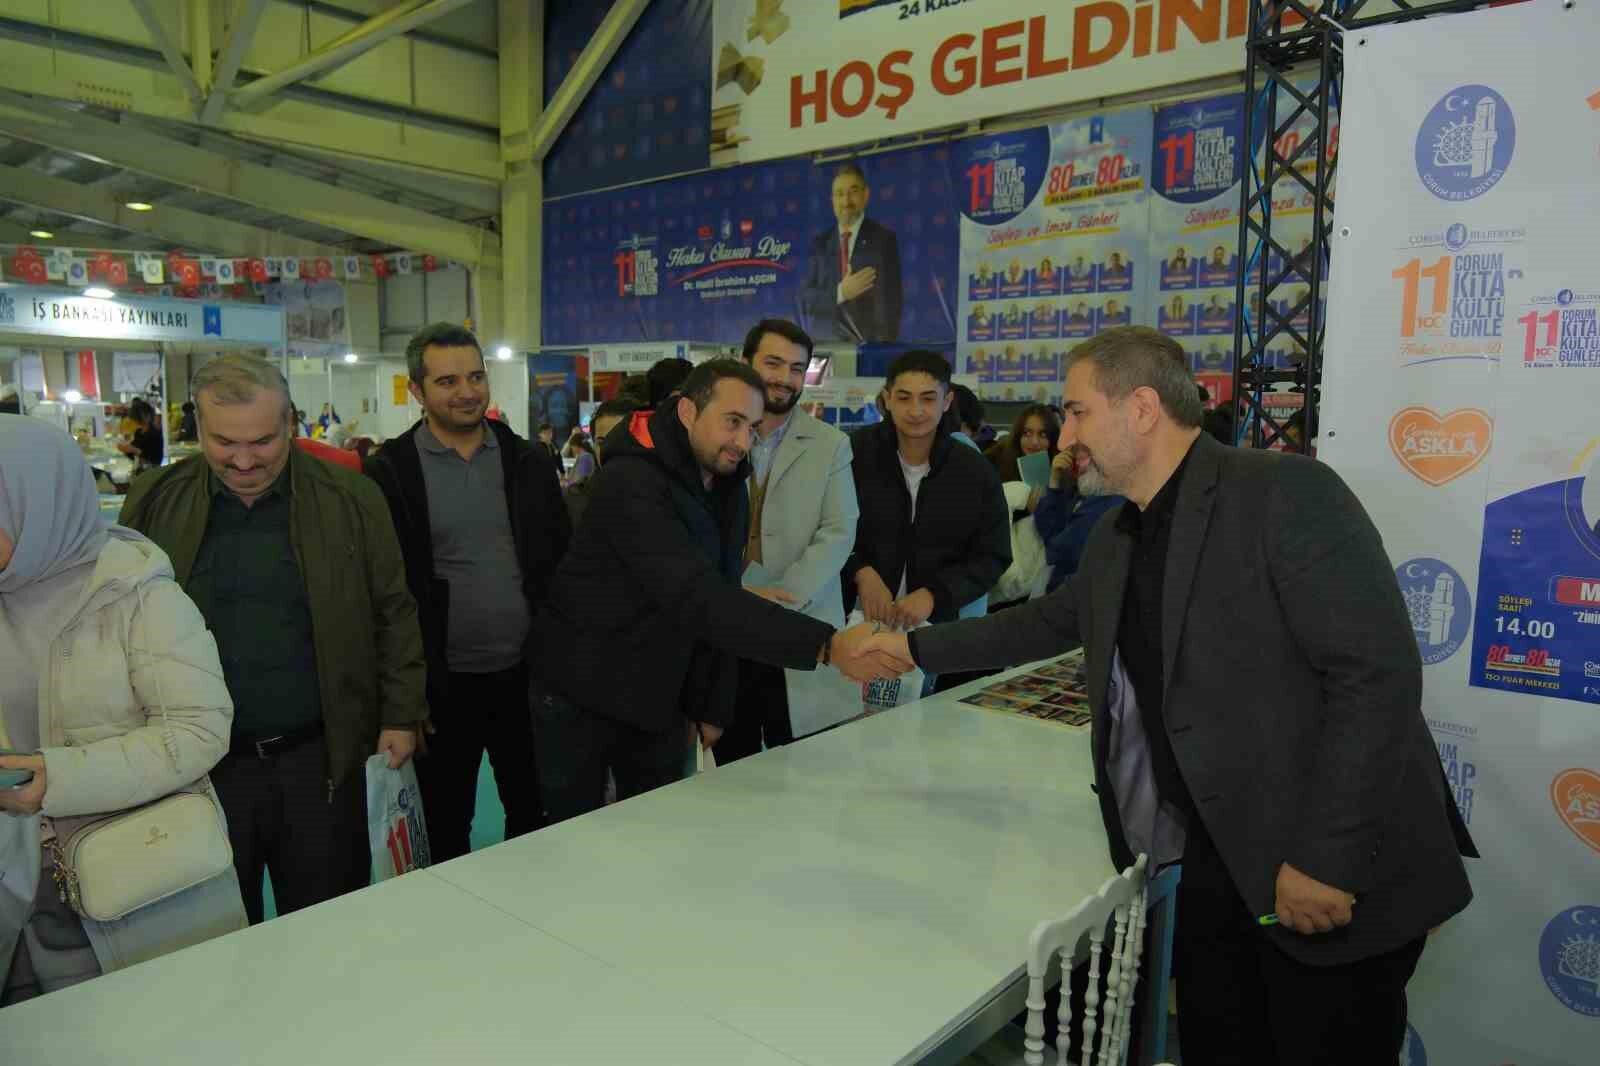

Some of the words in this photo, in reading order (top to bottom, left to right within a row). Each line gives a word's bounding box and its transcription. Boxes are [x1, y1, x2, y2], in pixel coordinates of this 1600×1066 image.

[897, 1, 920, 20] 24
[789, 50, 914, 128] HOŞ
[1047, 161, 1074, 193] 80
[1096, 153, 1125, 184] 80
[1160, 128, 1194, 190] 11
[966, 161, 993, 212] 11
[119, 307, 189, 329] YAYINLARI
[1391, 255, 1450, 337] 11
[1518, 310, 1560, 362] 11
[1561, 319, 1600, 337] KİTA
[1495, 615, 1555, 638] 14.00
[1487, 645, 1510, 663] 80
[1526, 648, 1550, 667] 80
[387, 816, 414, 876] 11
